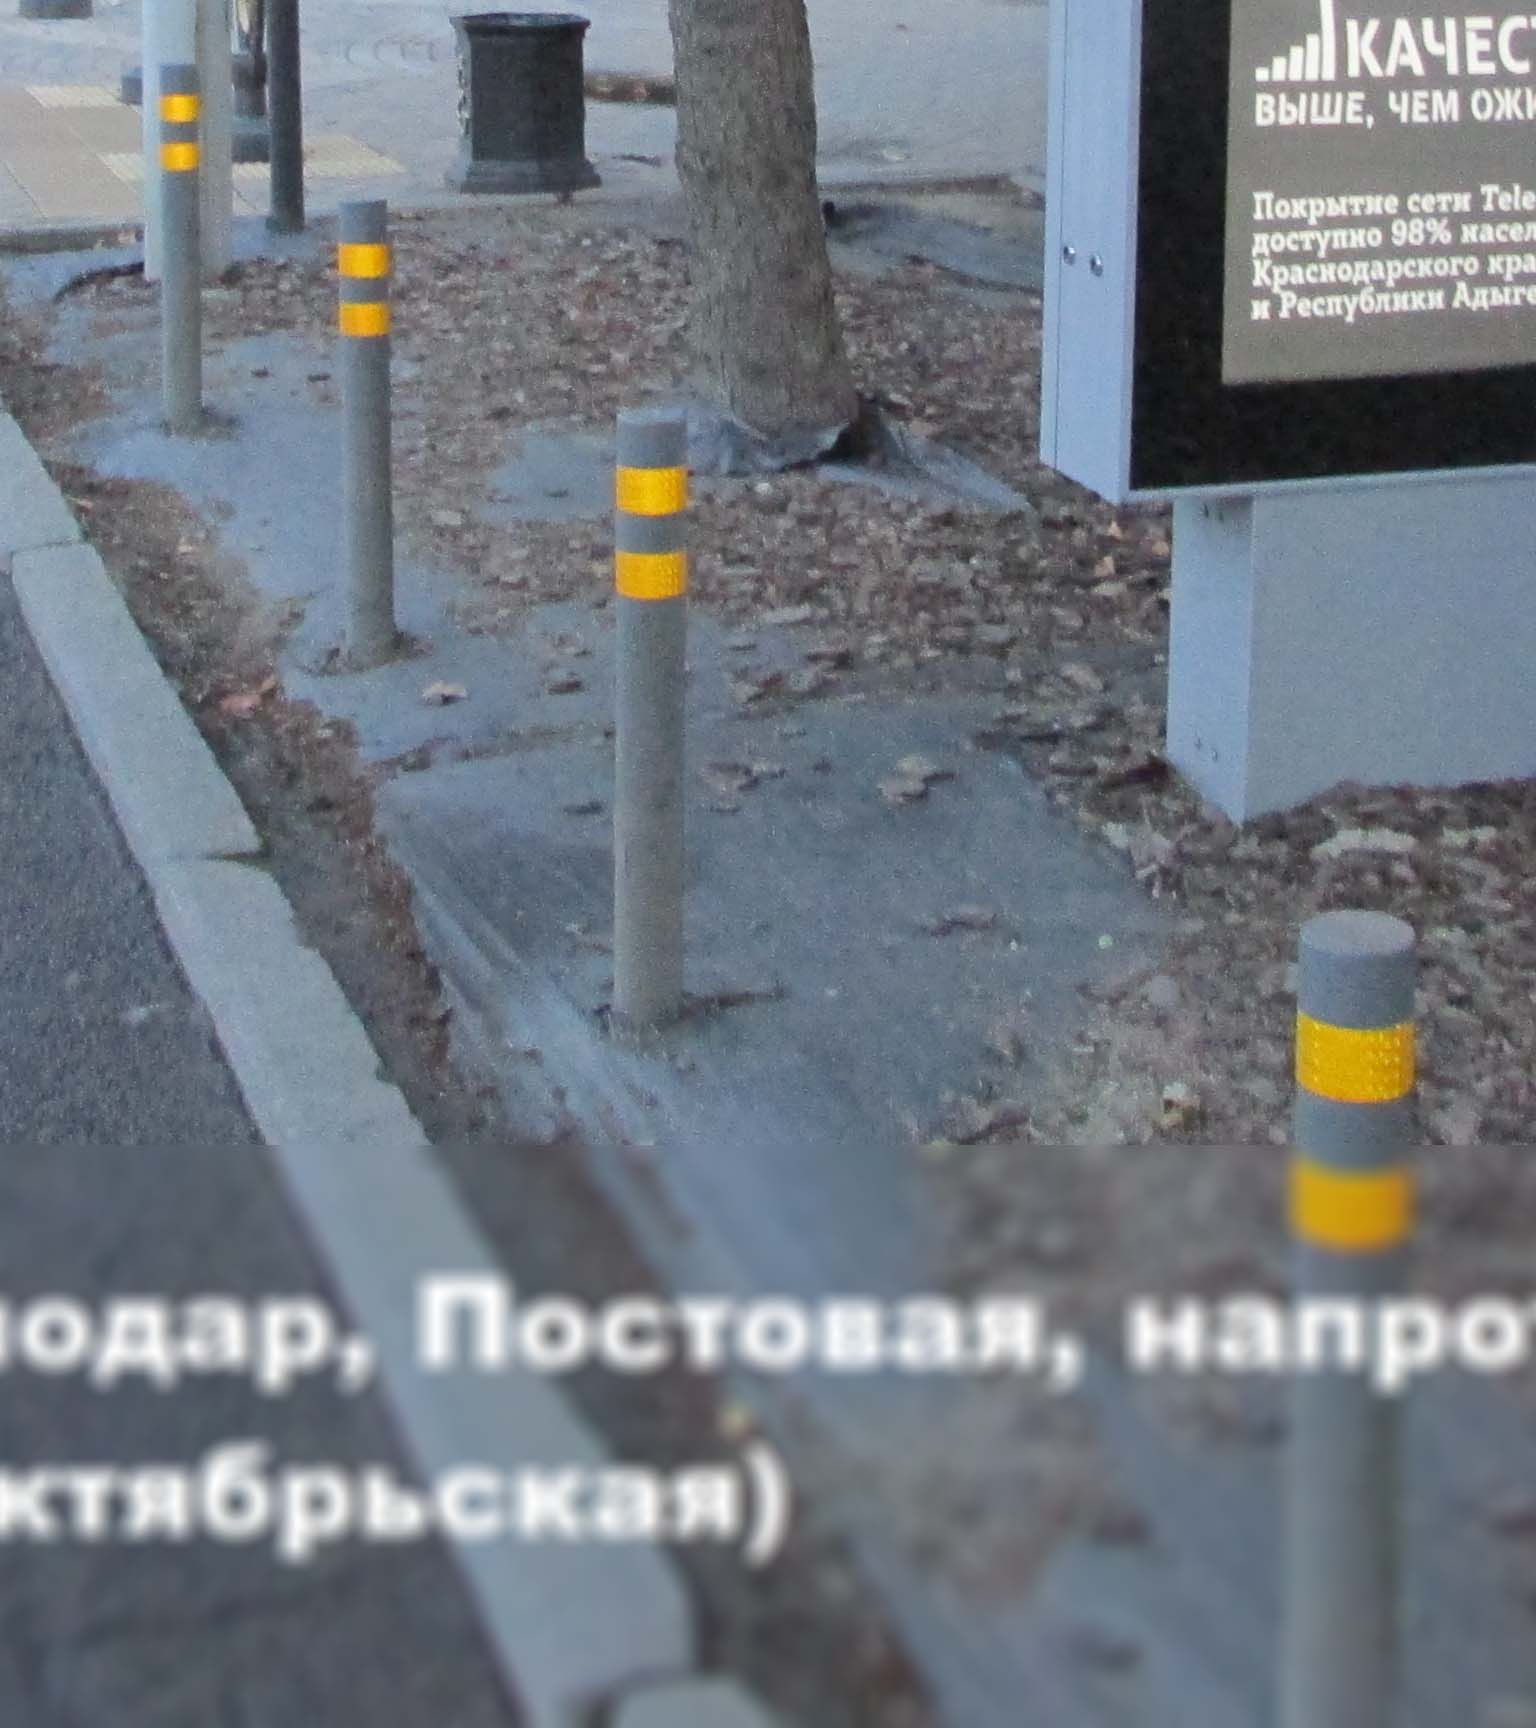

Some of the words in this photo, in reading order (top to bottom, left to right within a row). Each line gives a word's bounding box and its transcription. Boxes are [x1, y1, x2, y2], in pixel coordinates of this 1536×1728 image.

[1254, 91, 1375, 129] ВЫШЕ,
[1388, 88, 1460, 123] ЧЕМ
[1253, 190, 1400, 226] Покрытие
[1406, 191, 1472, 216] сети
[1251, 225, 1383, 259] доступно
[1391, 217, 1452, 246] 98%
[1252, 256, 1480, 293] Краснодарского
[1251, 298, 1271, 321] и
[1278, 286, 1446, 323] Республики
